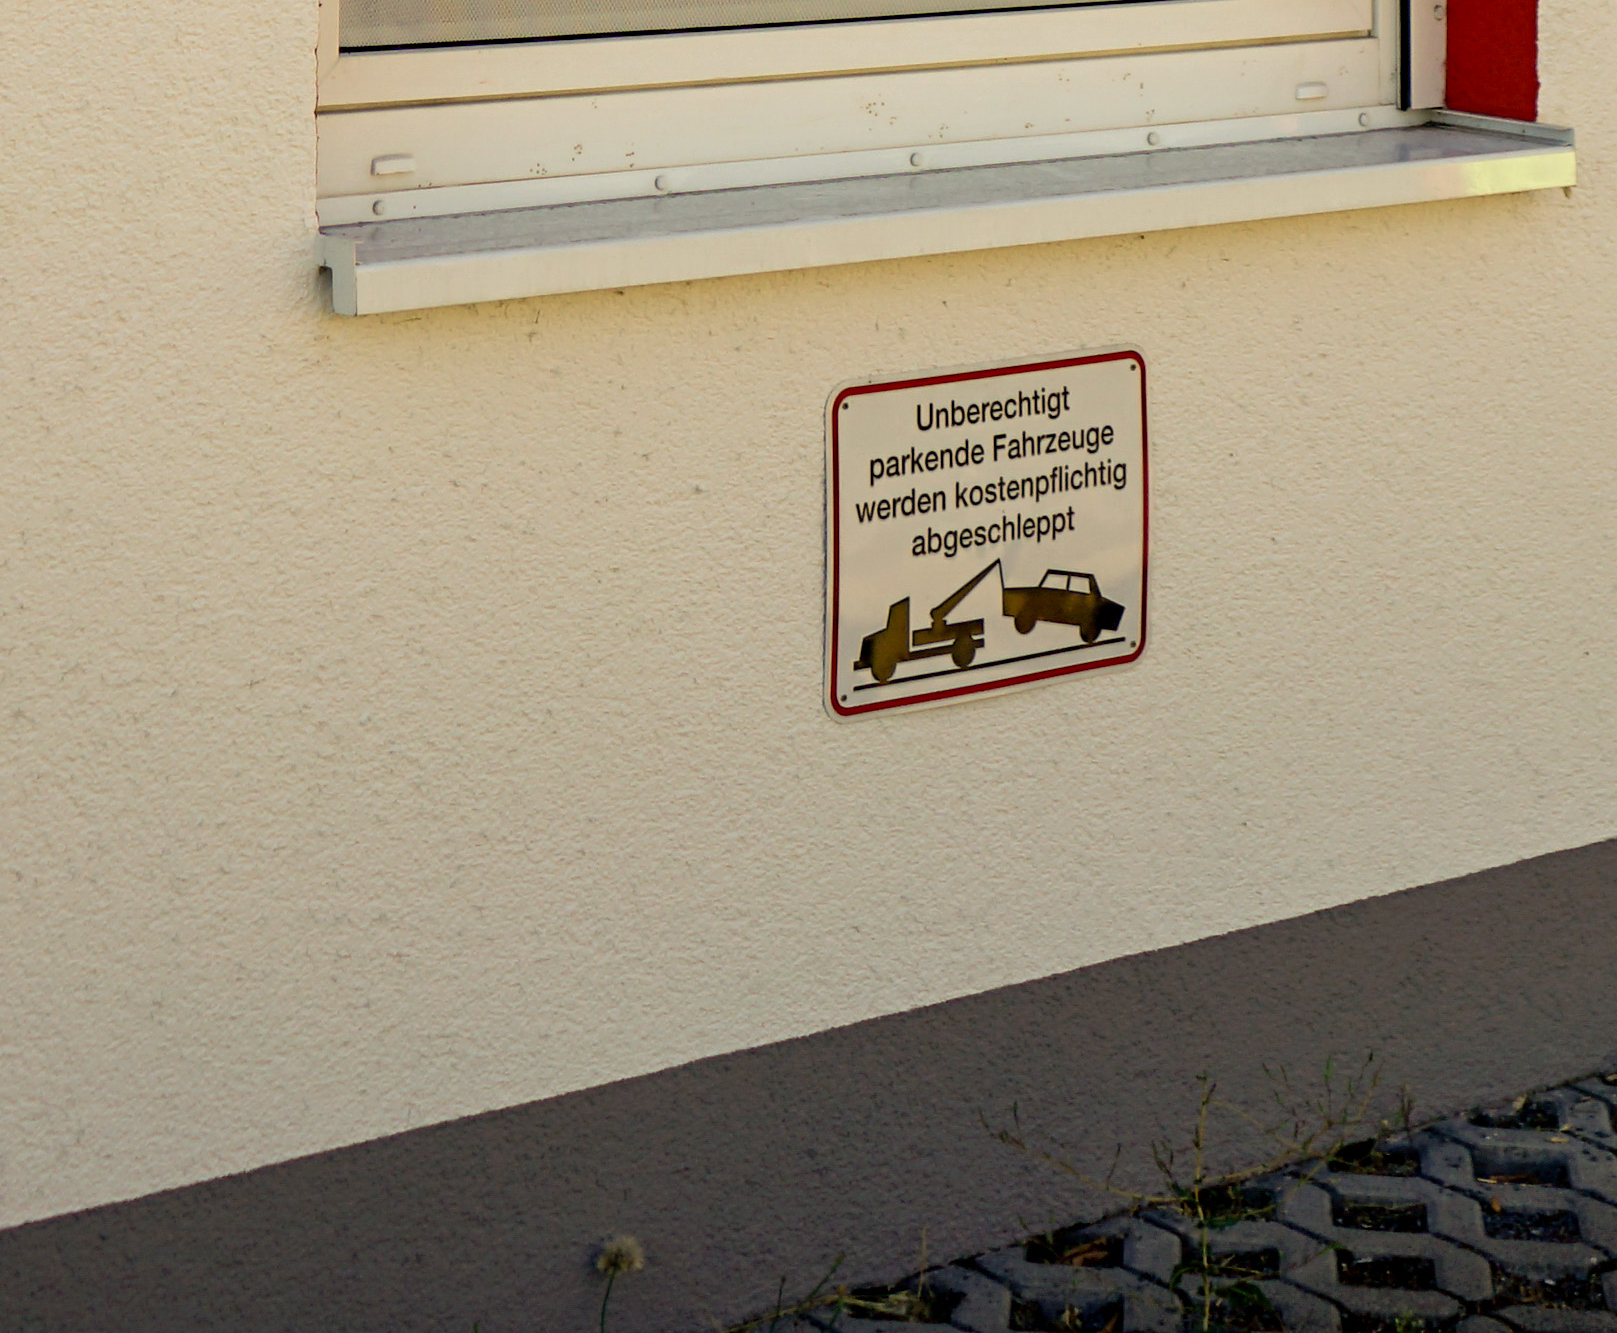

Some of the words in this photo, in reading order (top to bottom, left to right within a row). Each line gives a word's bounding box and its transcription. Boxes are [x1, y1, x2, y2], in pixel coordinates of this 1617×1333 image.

[915, 386, 1071, 432] Unberechtigt
[869, 439, 984, 486] parkende
[993, 423, 1115, 462] Fahrzeuge
[856, 488, 946, 523] werden
[955, 458, 1128, 510] kostenpflichtig
[911, 505, 1076, 558] abgeschleppt
